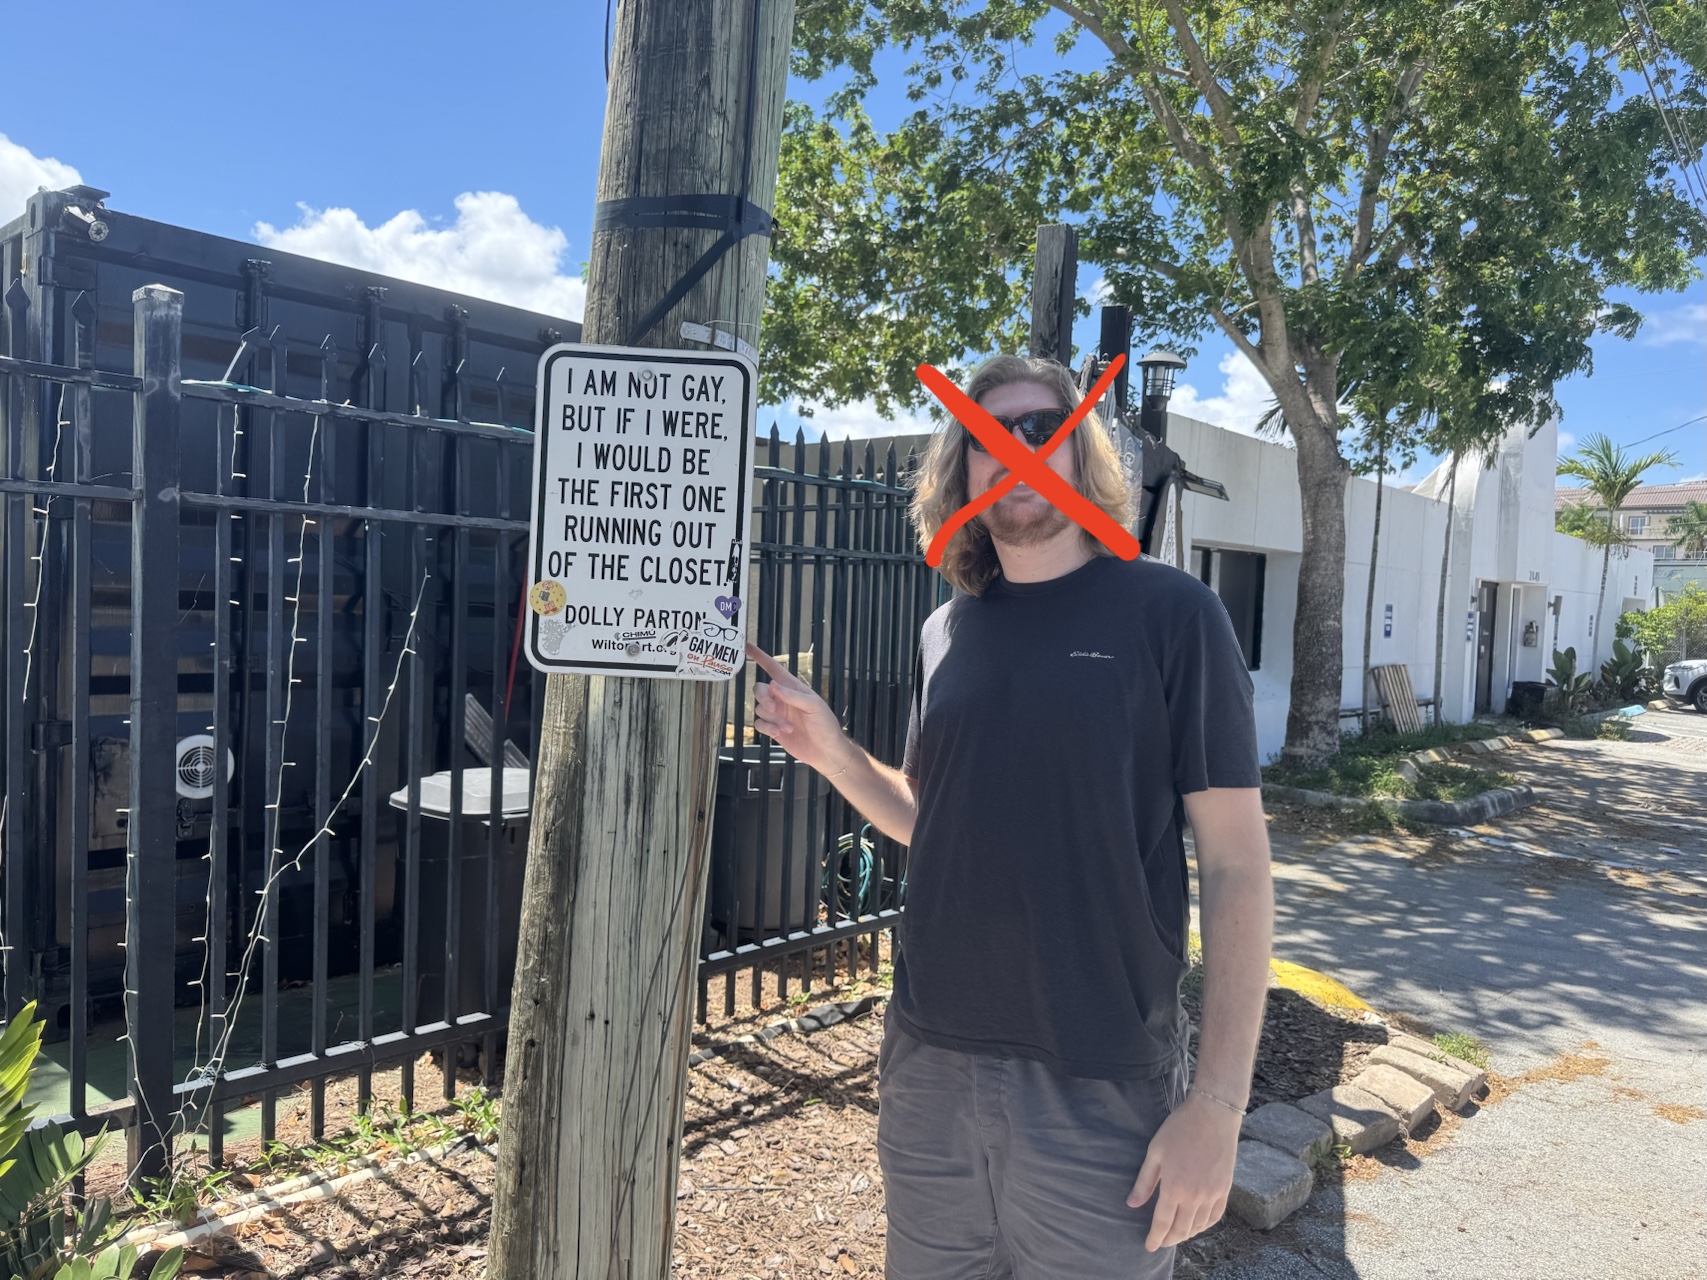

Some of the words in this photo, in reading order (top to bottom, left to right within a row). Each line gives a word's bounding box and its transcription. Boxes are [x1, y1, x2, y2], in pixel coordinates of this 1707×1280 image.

[567, 368, 573, 394] I
[583, 370, 617, 397] AM
[628, 372, 672, 399] NOT
[682, 375, 726, 405] GAY,
[562, 404, 606, 432] BUT
[616, 407, 635, 434] IF
[645, 409, 651, 436] I
[662, 410, 728, 442] WERE,
[576, 442, 582, 468] I
[594, 443, 671, 473] WOULD
[682, 448, 711, 475] BE
[558, 478, 600, 506] THE
[610, 481, 672, 510] FIRST
[682, 485, 727, 513] ONE
[564, 515, 662, 546] RUNNING
[673, 520, 717, 549] OUT
[548, 551, 577, 578] OF
[588, 553, 630, 581] THE
[565, 604, 625, 627] DOLLY
[634, 609, 707, 631] PARTON
[720, 601, 737, 612] DMC
[592, 639, 677, 655] Wiltort.o
[622, 629, 656, 638] CHIMÚ
[689, 636, 713, 655] GAY
[712, 643, 739, 664] MEN
[701, 654, 733, 671] Pause
